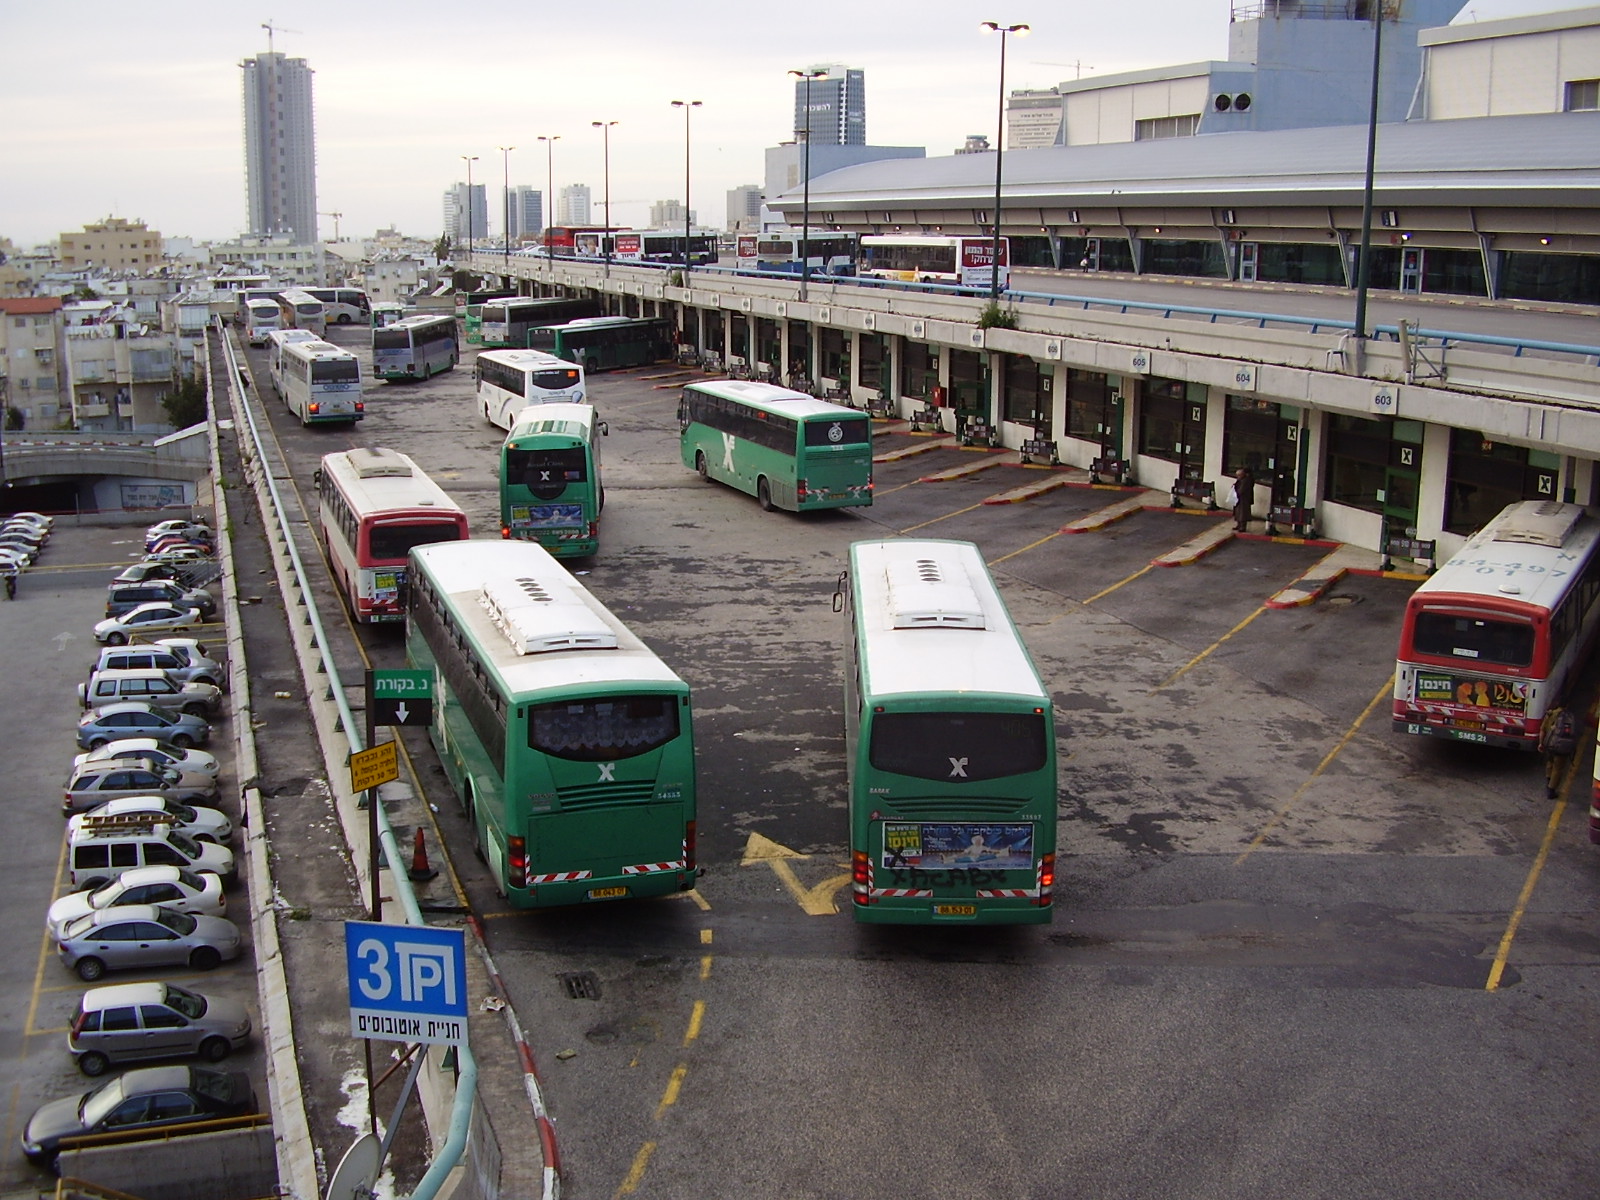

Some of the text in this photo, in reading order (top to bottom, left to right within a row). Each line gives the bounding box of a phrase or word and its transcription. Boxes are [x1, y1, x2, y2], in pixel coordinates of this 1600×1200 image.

[1132, 358, 1146, 366] 605
[1236, 373, 1250, 382] 604
[1375, 395, 1392, 406] 603
[376, 678, 415, 693] בקורת
[1419, 679, 1451, 690] חינם!
[1458, 731, 1476, 741] SMS
[357, 938, 392, 1001] 3
[358, 1015, 460, 1039] חניית אוטובוסים
